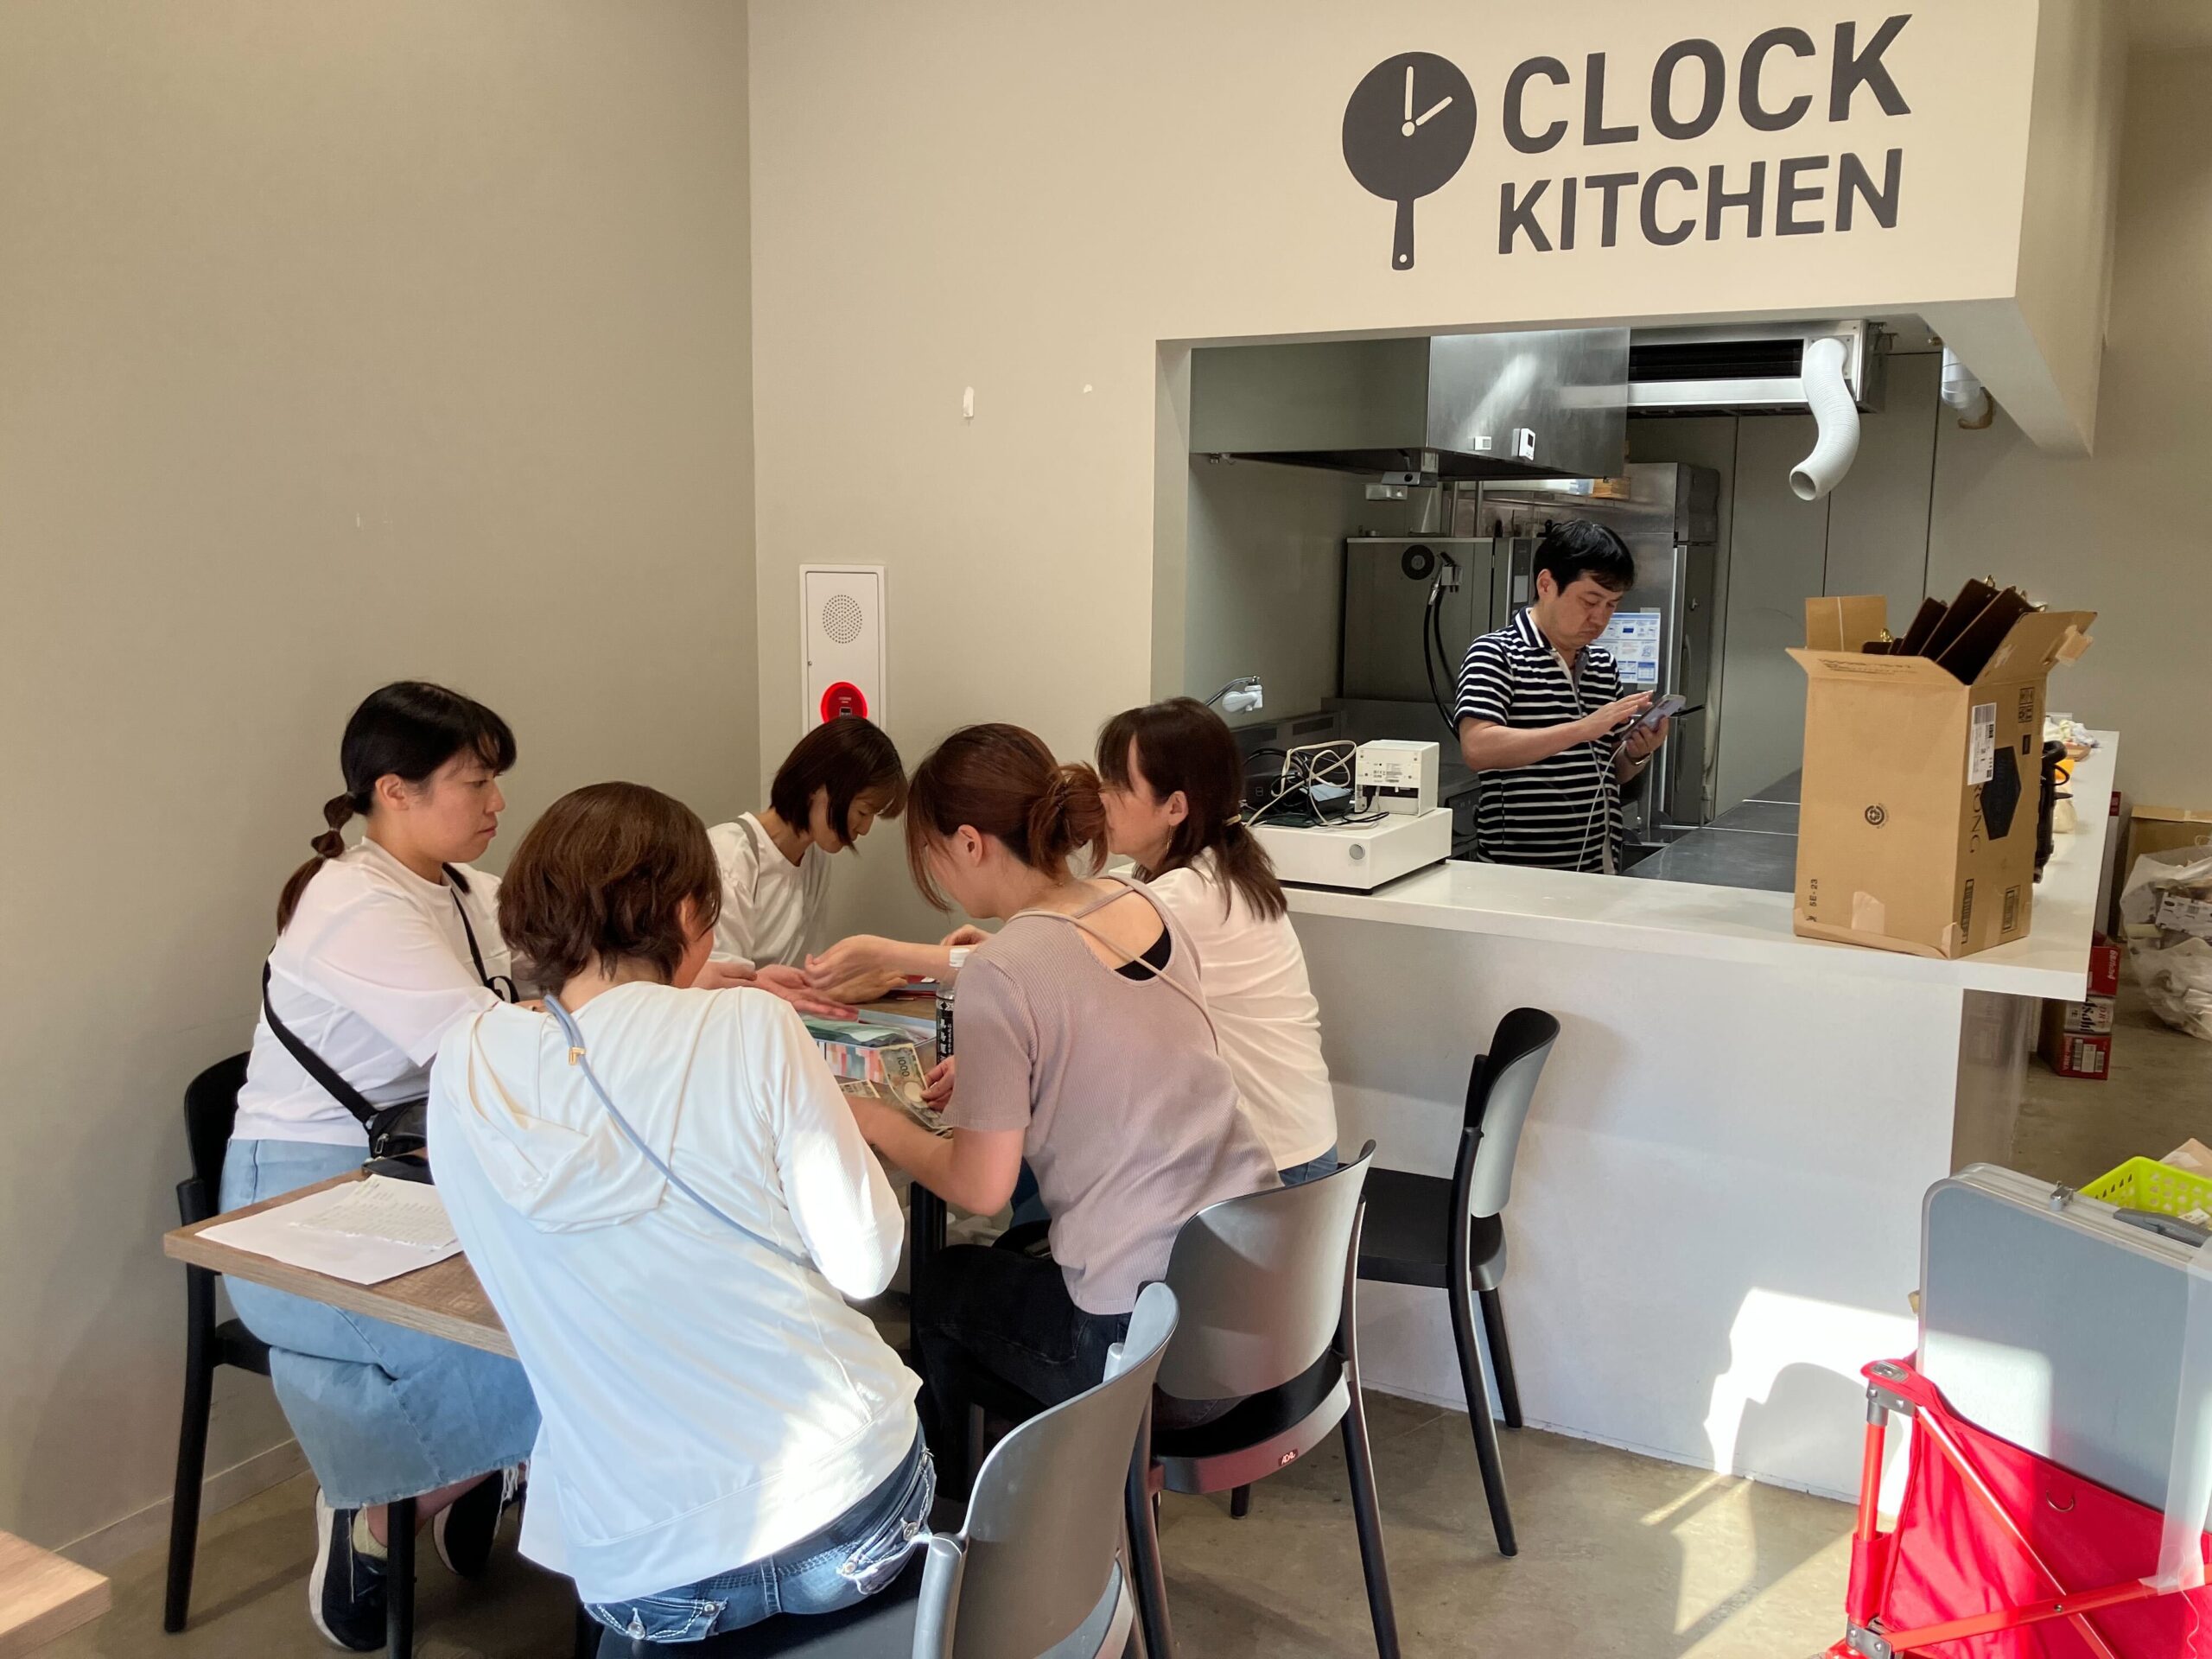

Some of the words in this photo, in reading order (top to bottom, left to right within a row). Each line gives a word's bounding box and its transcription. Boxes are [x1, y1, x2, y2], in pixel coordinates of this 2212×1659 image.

[1503, 13, 1913, 155] CLOCK
[1498, 148, 1903, 255] KITCHEN
[897, 1057, 911, 1077] 1000
